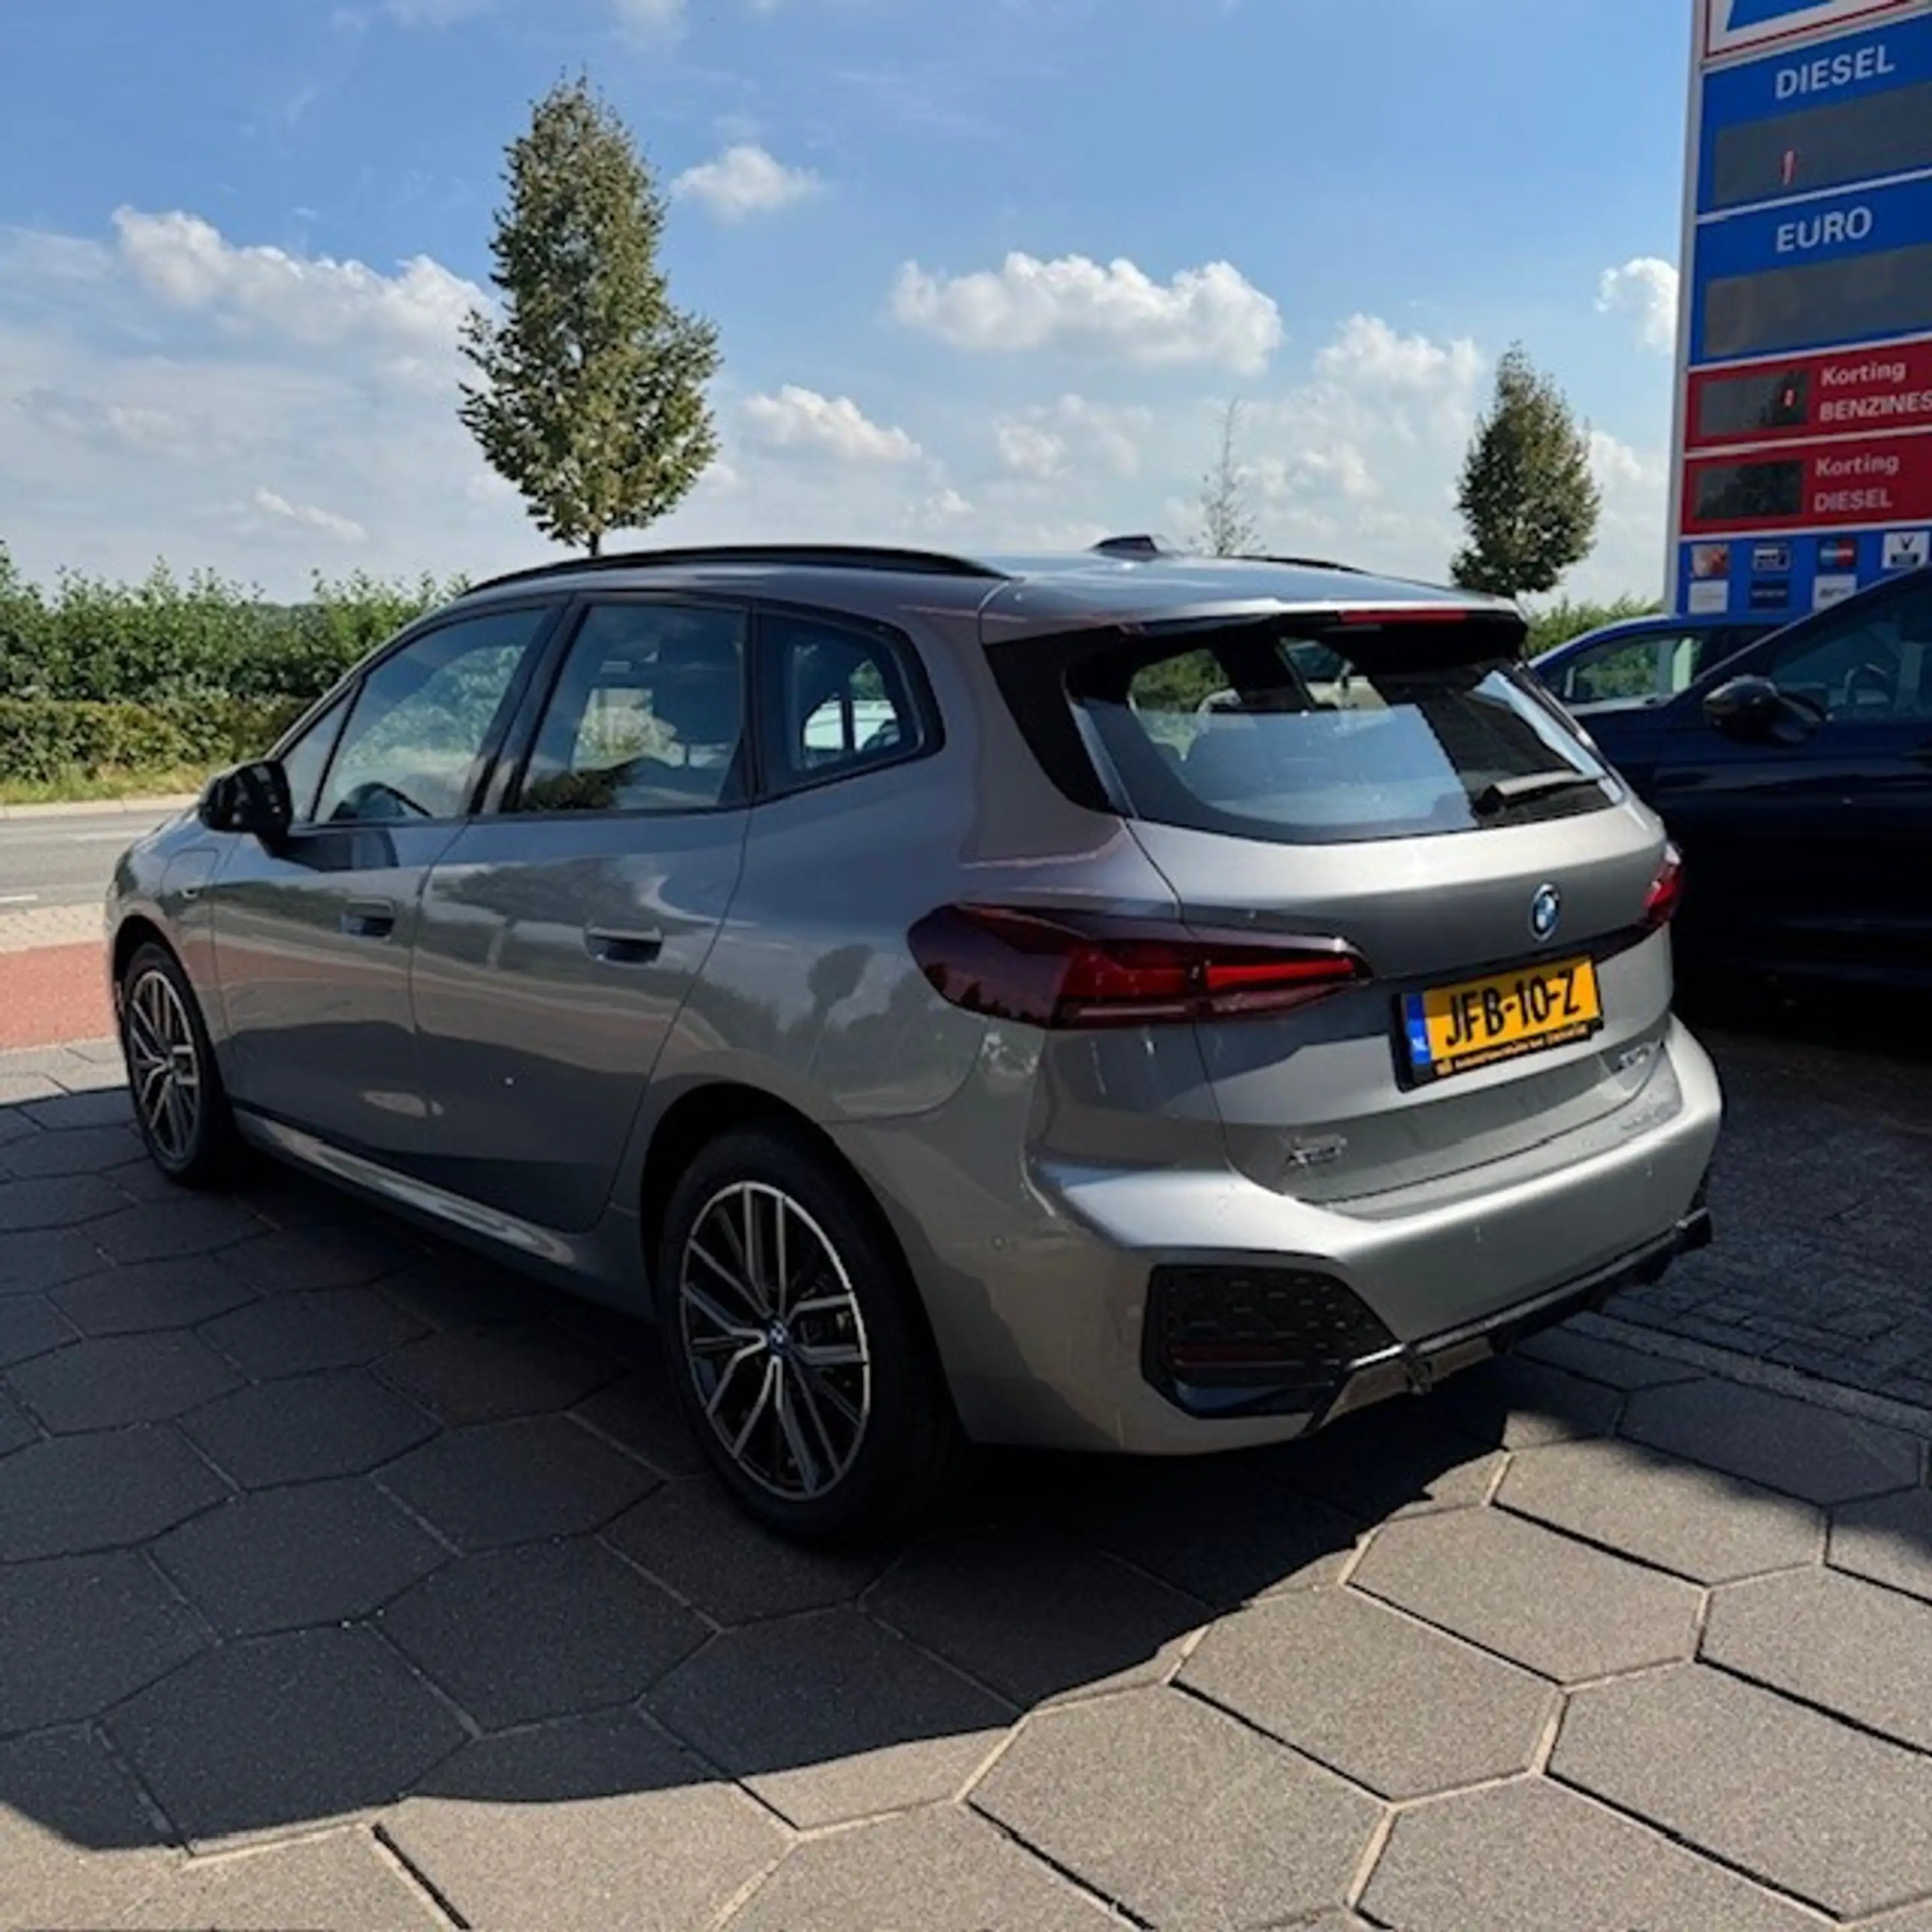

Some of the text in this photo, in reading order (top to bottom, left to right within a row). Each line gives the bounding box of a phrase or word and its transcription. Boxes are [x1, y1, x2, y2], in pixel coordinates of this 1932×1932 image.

[1774, 45, 1896, 100] DIESEL
[1776, 206, 1872, 254] EURO
[1821, 361, 1906, 387] Korting
[1815, 453, 1900, 478] Korting
[1814, 488, 1893, 513] DIESEL
[1446, 968, 1579, 1047] JFB-10-Z
